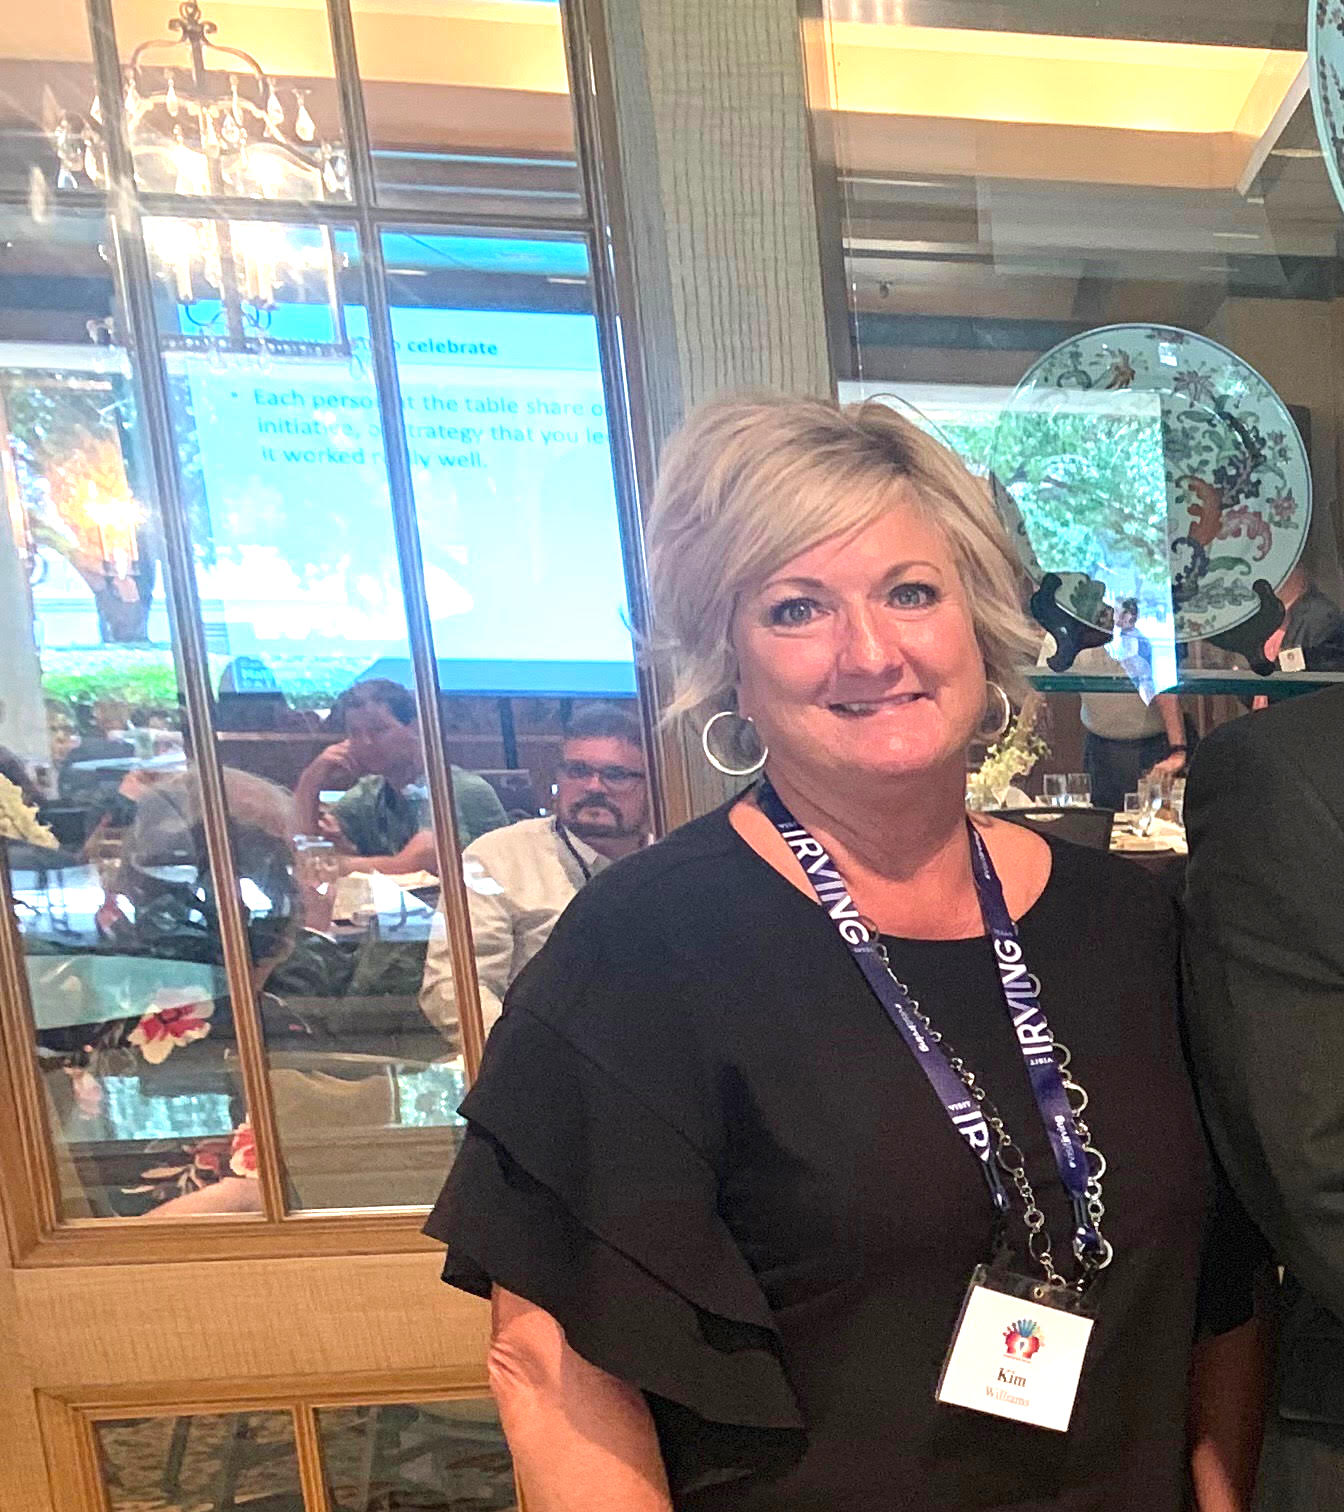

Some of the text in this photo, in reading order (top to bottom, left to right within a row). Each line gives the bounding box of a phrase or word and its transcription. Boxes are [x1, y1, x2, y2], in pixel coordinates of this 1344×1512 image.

[407, 338, 499, 356] celebrate
[254, 388, 305, 407] Each
[312, 394, 373, 410] perso
[423, 394, 458, 411] the
[465, 397, 518, 415] table
[526, 401, 584, 416] share
[407, 424, 483, 444] trategy
[491, 427, 533, 443] that
[540, 430, 578, 446] you
[585, 427, 607, 444] le
[262, 447, 275, 462] it
[283, 448, 365, 465] worked
[439, 452, 488, 469] well.
[782, 830, 870, 945] IRVING
[994, 938, 1054, 1056] IRVING
[1030, 1056, 1054, 1066] VISIT
[948, 1100, 971, 1111] VISIT
[997, 1367, 1027, 1388] Kim
